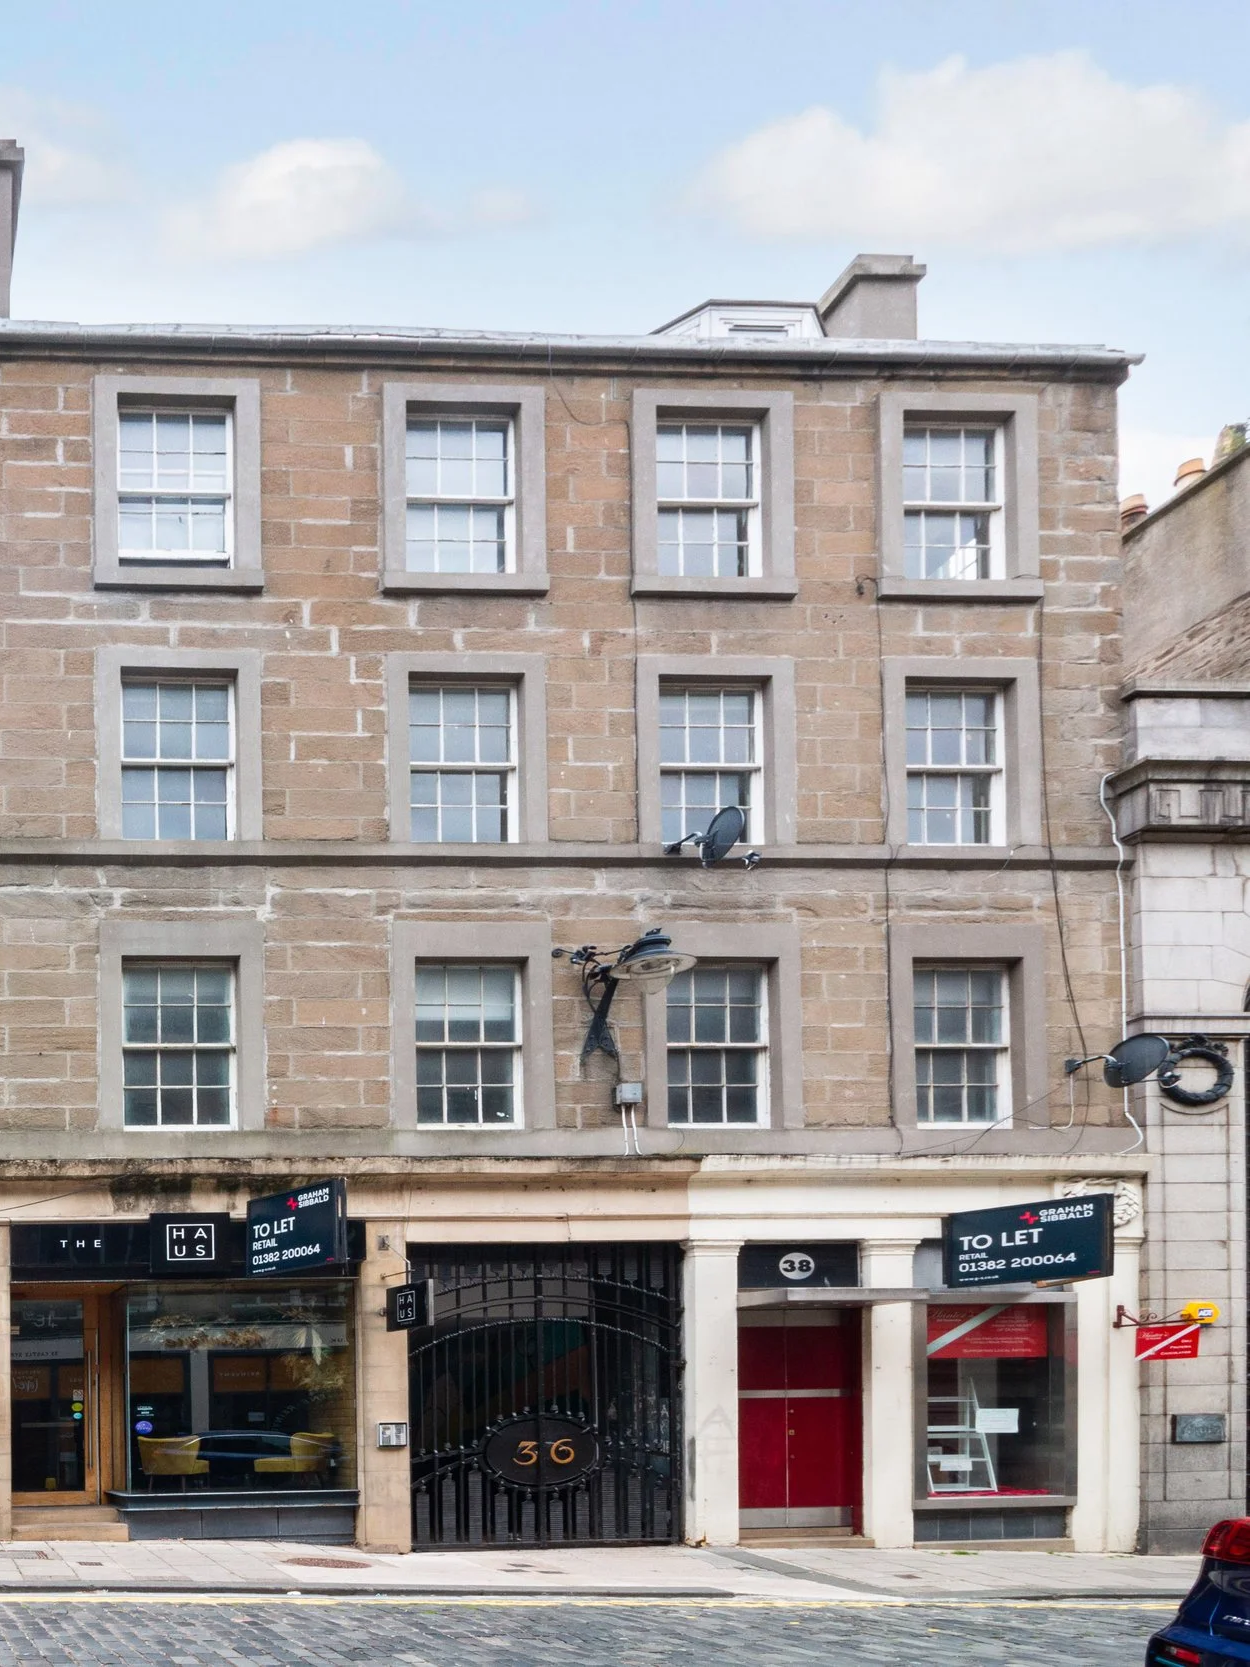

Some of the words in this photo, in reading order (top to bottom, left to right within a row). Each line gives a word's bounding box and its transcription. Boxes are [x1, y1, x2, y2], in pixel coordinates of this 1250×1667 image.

[297, 1187, 329, 1202] GRAHAM
[298, 1194, 330, 1209] SIBBALD
[1038, 1203, 1094, 1216] GRAHAM
[1039, 1210, 1094, 1223] SIBBALD
[253, 1223, 270, 1239] TO
[273, 1216, 296, 1235] LET
[60, 1239, 102, 1248] THE
[252, 1237, 278, 1251] RETAIL
[959, 1234, 993, 1251] TO
[1001, 1228, 1043, 1247] LET
[252, 1251, 280, 1265] 01382
[281, 1243, 320, 1260] 200064
[958, 1252, 989, 1261] RETAIL
[782, 1259, 812, 1273] 38
[958, 1259, 1006, 1273] 01382
[1010, 1252, 1077, 1269] 200064
[512, 1438, 575, 1466] 36
